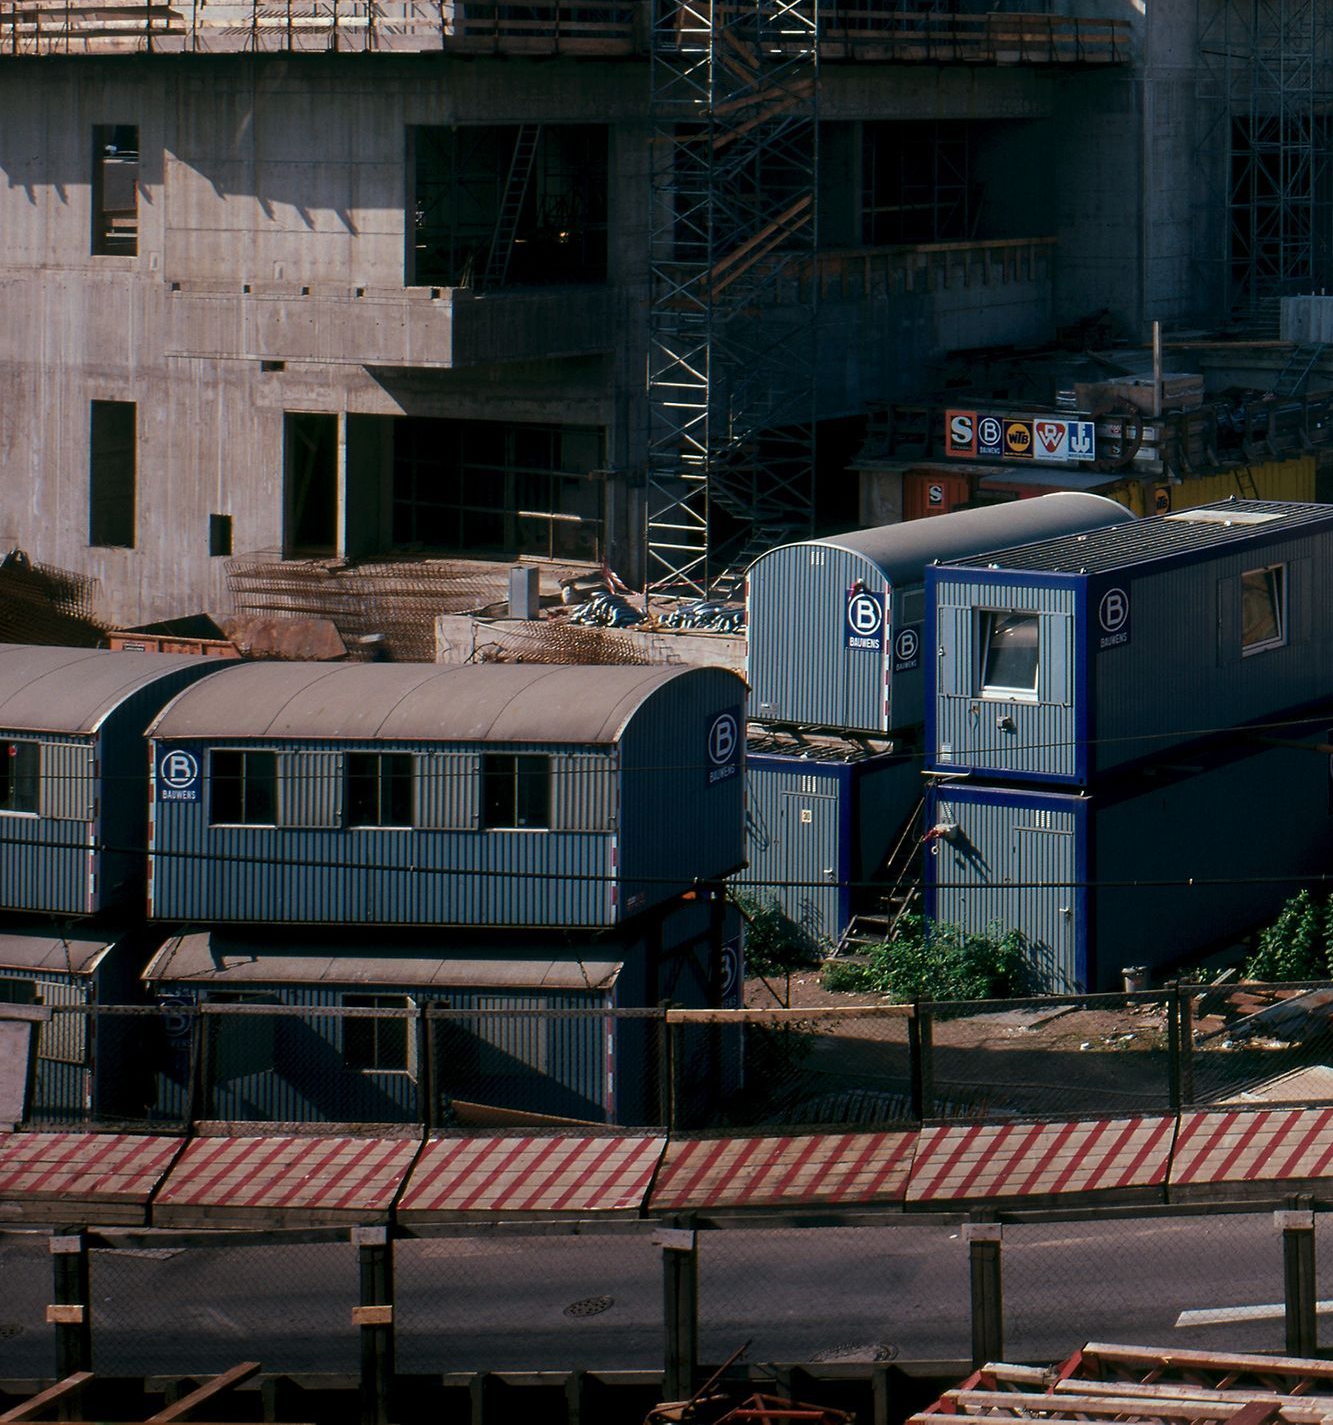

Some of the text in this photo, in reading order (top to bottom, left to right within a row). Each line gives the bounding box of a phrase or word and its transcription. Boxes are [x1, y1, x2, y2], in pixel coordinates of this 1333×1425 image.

[951, 416, 972, 443] S
[984, 422, 998, 441] B
[1008, 430, 1029, 444] WTB
[929, 486, 942, 501] S
[857, 599, 876, 629] B
[1106, 594, 1123, 626] B
[849, 636, 880, 649] BAUWENS
[901, 634, 914, 656] B
[1100, 632, 1127, 648] BAUWENS
[716, 720, 733, 757] B
[170, 756, 191, 781] B
[709, 763, 736, 783] BAUWENS
[162, 790, 196, 800] BAUWENS
